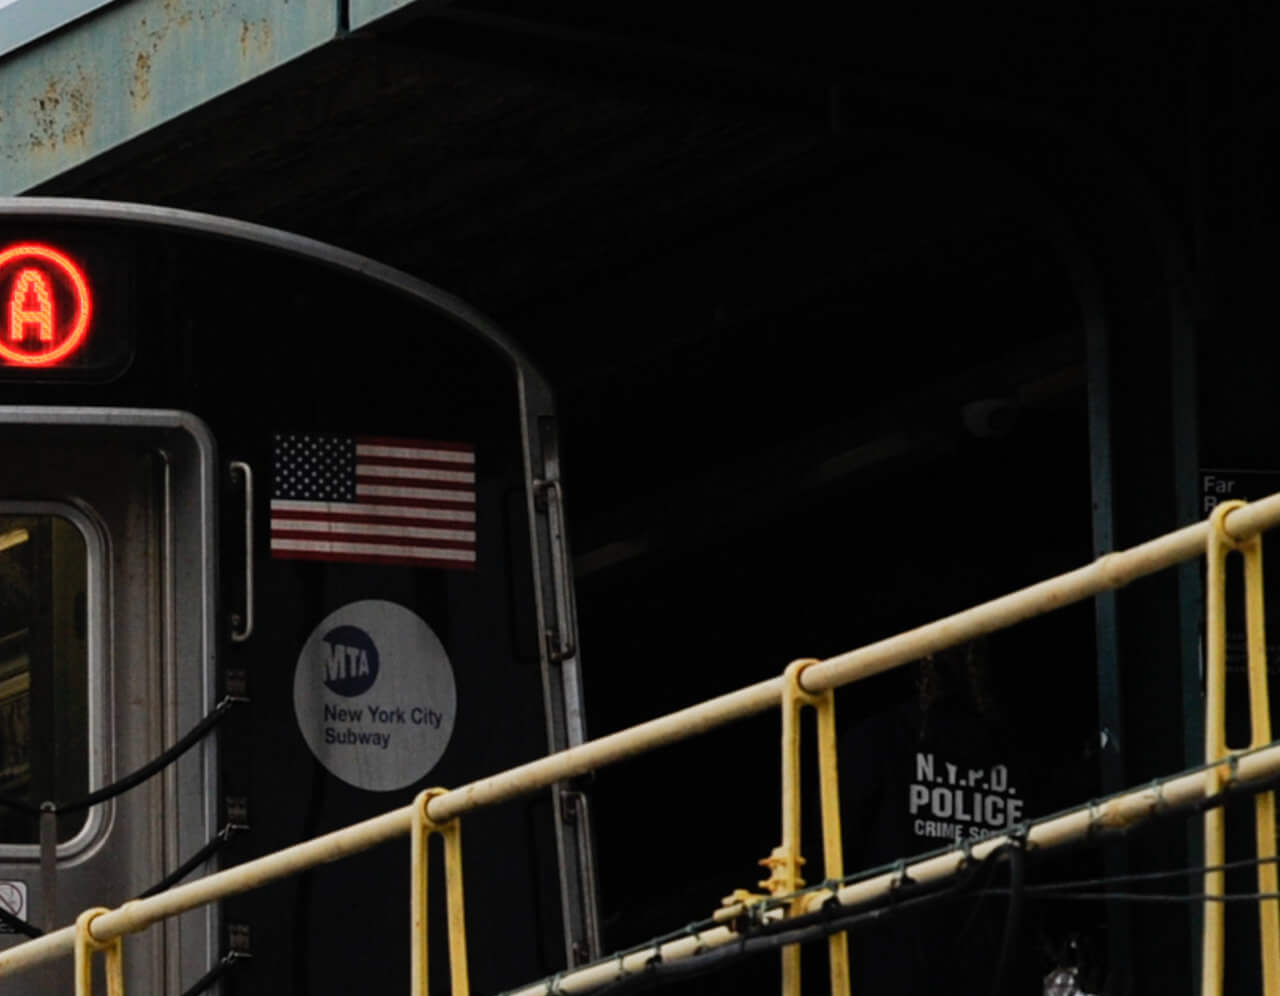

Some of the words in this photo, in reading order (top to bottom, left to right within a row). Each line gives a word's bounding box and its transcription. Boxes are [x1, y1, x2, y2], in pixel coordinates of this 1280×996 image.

[10, 268, 54, 341] A
[1203, 476, 1235, 493] Far
[321, 640, 369, 681] MTA
[324, 704, 363, 723] New
[367, 705, 406, 724] York
[410, 707, 443, 729] City
[324, 727, 390, 750] Subway
[909, 784, 1024, 828] POLICE
[914, 819, 964, 840] CRIME
